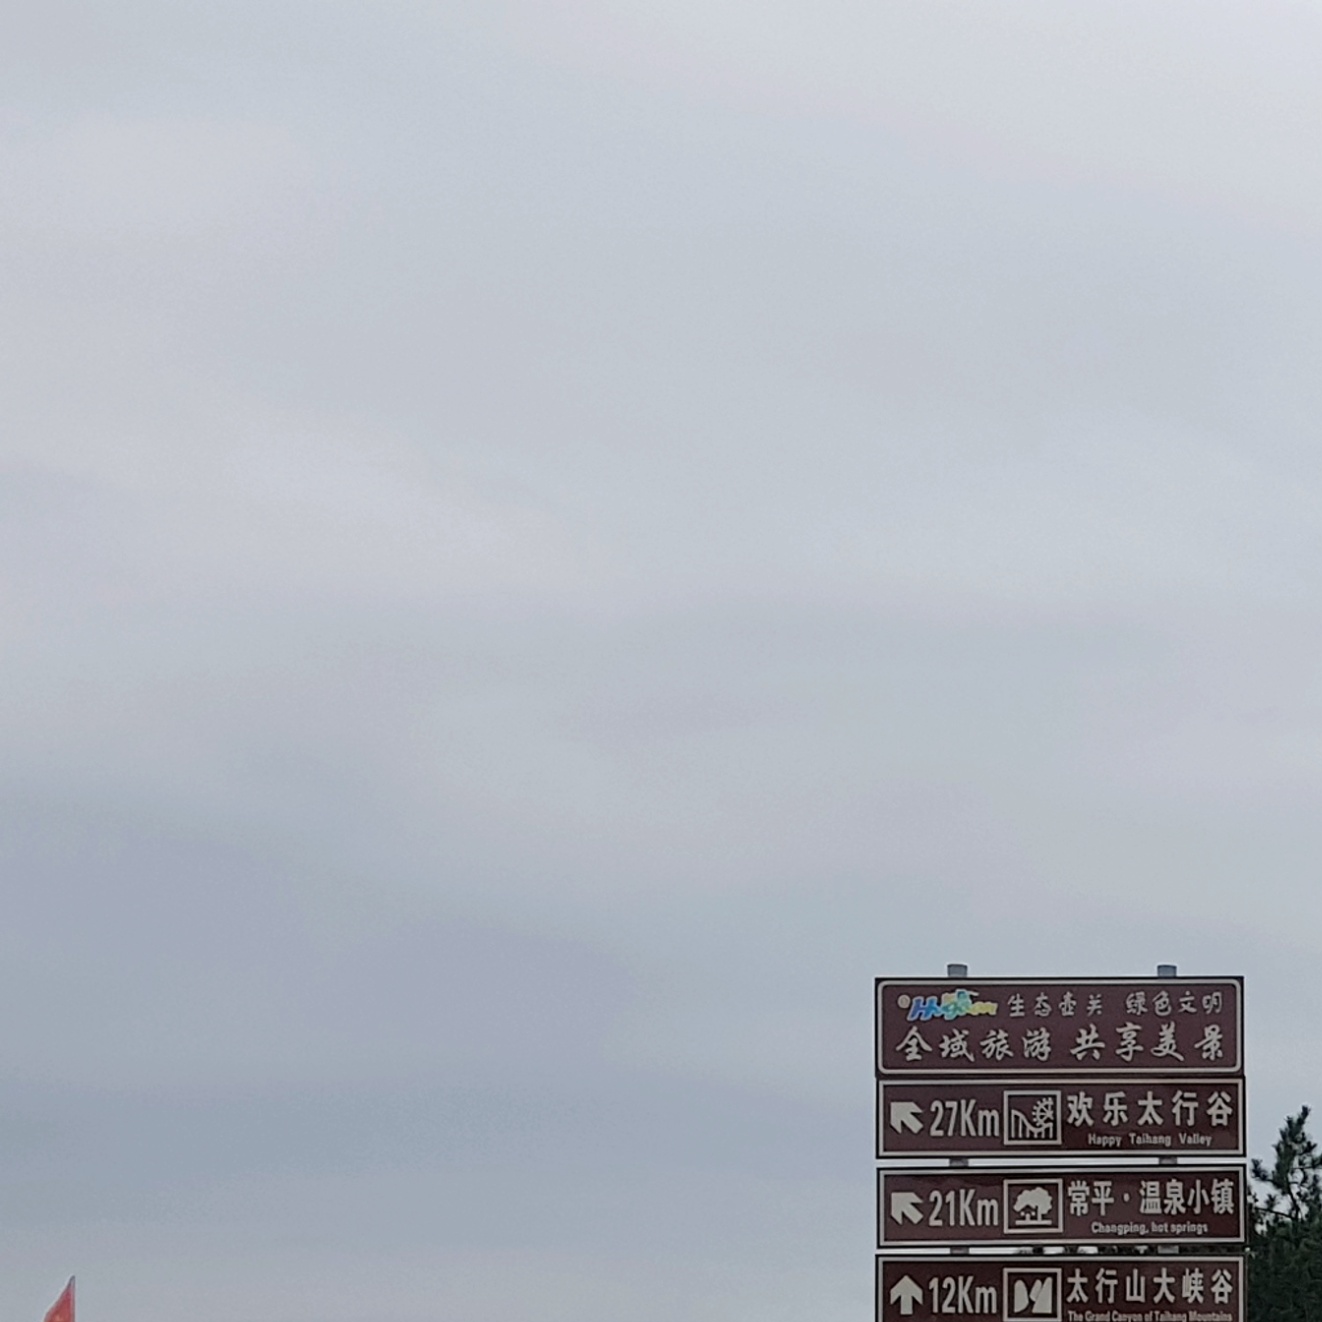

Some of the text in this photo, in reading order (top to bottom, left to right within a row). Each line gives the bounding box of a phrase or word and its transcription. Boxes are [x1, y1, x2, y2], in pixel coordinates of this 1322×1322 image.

[1007, 990, 1223, 1018] 生态壶关 绿色文明
[895, 1021, 1224, 1062] 全域旅游 共享美景
[930, 1099, 1000, 1137] 27Km
[1066, 1089, 1234, 1128] 欢乐太行谷
[1088, 1132, 1213, 1147] Happy Taihang Valley
[930, 1190, 999, 1227] 21Km
[1151, 1221, 1169, 1233] hot
[1171, 1221, 1208, 1235] springs
[928, 1275, 998, 1315] 12Km
[1066, 1267, 1234, 1305] 太行山大峡谷
[1068, 1311, 1083, 1322] The
[1085, 1311, 1110, 1322] Grand
[1144, 1311, 1153, 1322] of
[1188, 1311, 1233, 1322] Mountains
